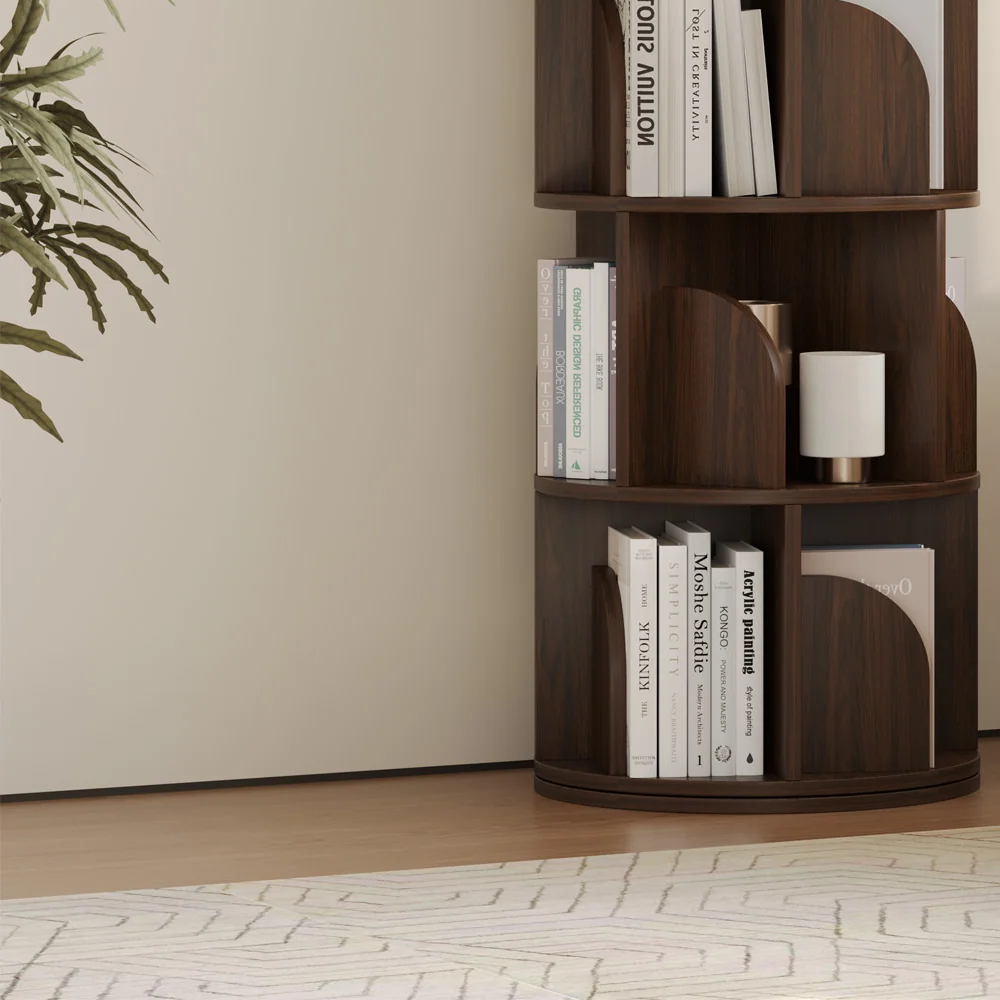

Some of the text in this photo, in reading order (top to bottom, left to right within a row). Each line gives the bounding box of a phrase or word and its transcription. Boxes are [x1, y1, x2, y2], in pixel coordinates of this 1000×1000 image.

[639, 621, 650, 691] KINFOLK
[668, 562, 679, 677] SIMPLICITY
[693, 553, 709, 674] Moshe Safdie
[719, 606, 729, 651] KONGO:
[742, 570, 755, 675] Acrylic painting
[745, 710, 753, 737] painting
